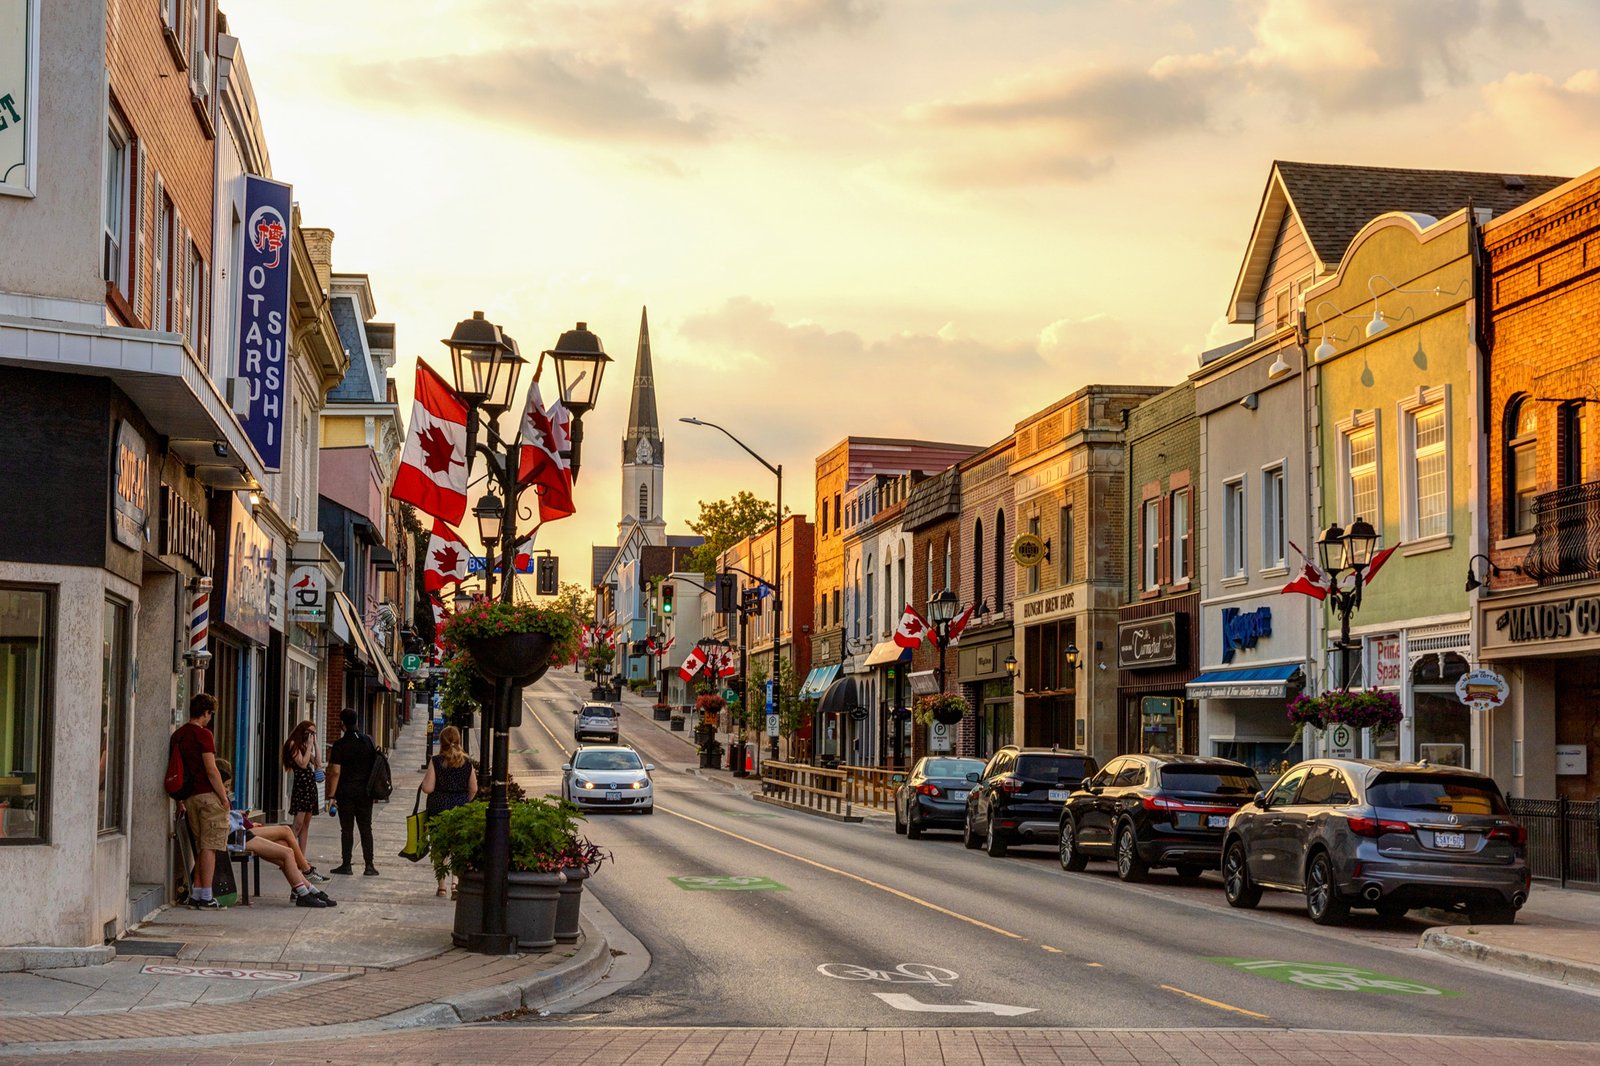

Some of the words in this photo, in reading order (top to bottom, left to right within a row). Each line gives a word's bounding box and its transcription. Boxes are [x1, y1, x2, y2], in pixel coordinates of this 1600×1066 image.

[246, 265, 265, 401] OTARU
[264, 310, 281, 446] SUSHI
[1024, 600, 1045, 618] HUNGRY
[1045, 596, 1060, 613] BREW
[1060, 592, 1075, 610] HOPS
[1377, 641, 1400, 661] Prime
[1377, 662, 1400, 681] Space
[726, 690, 734, 699] P
[1338, 731, 1346, 742] P
